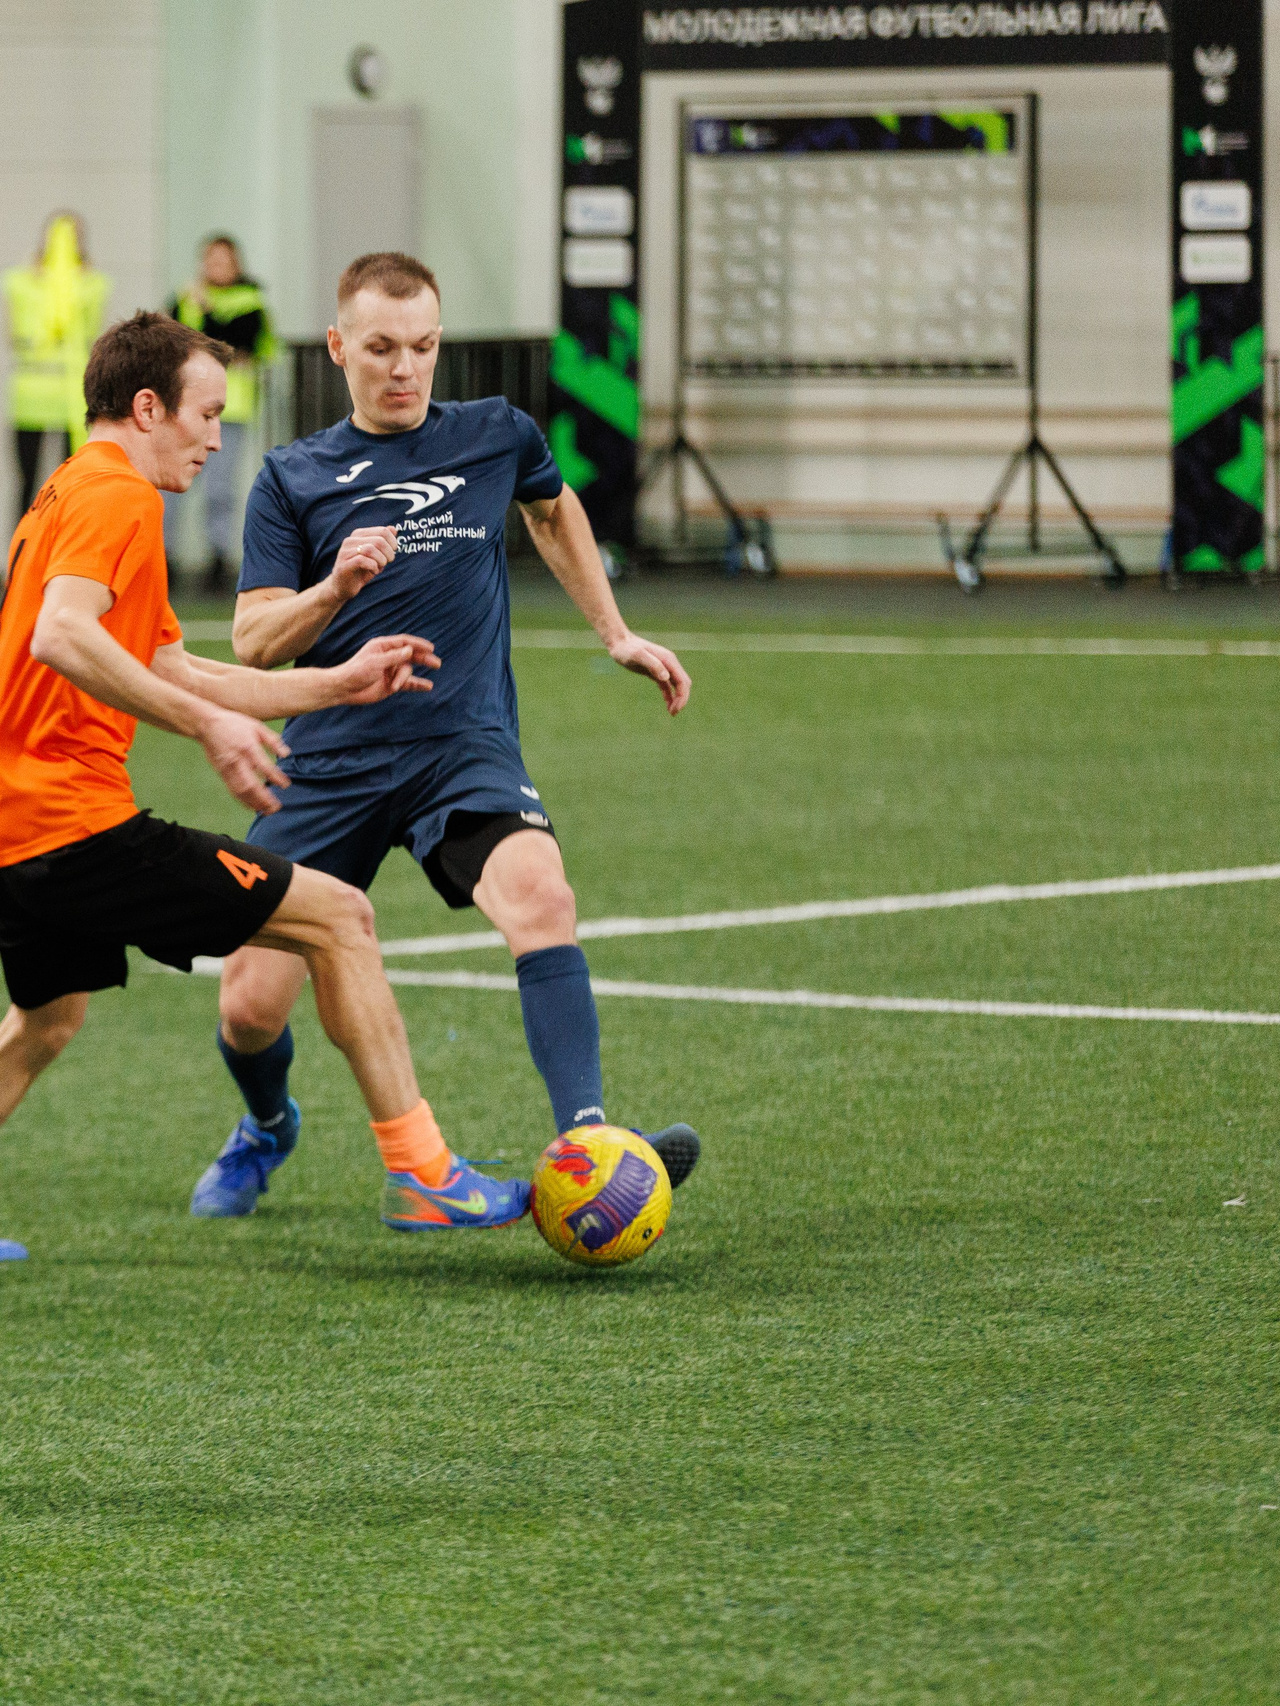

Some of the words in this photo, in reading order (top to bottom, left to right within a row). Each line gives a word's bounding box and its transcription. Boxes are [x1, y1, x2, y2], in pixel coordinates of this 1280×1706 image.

[645, 8, 867, 47] МОЛОДЕЖНАЯ
[869, 3, 1082, 39] ФУТБОЛЬНАЯ
[1085, 1, 1168, 34] ЛИГА
[395, 510, 453, 532] АЛЬСКИЙ
[396, 526, 486, 545] ОЫШЛЕННЫЙ
[397, 541, 443, 555] ЛДИНГ
[216, 849, 268, 890] 4
